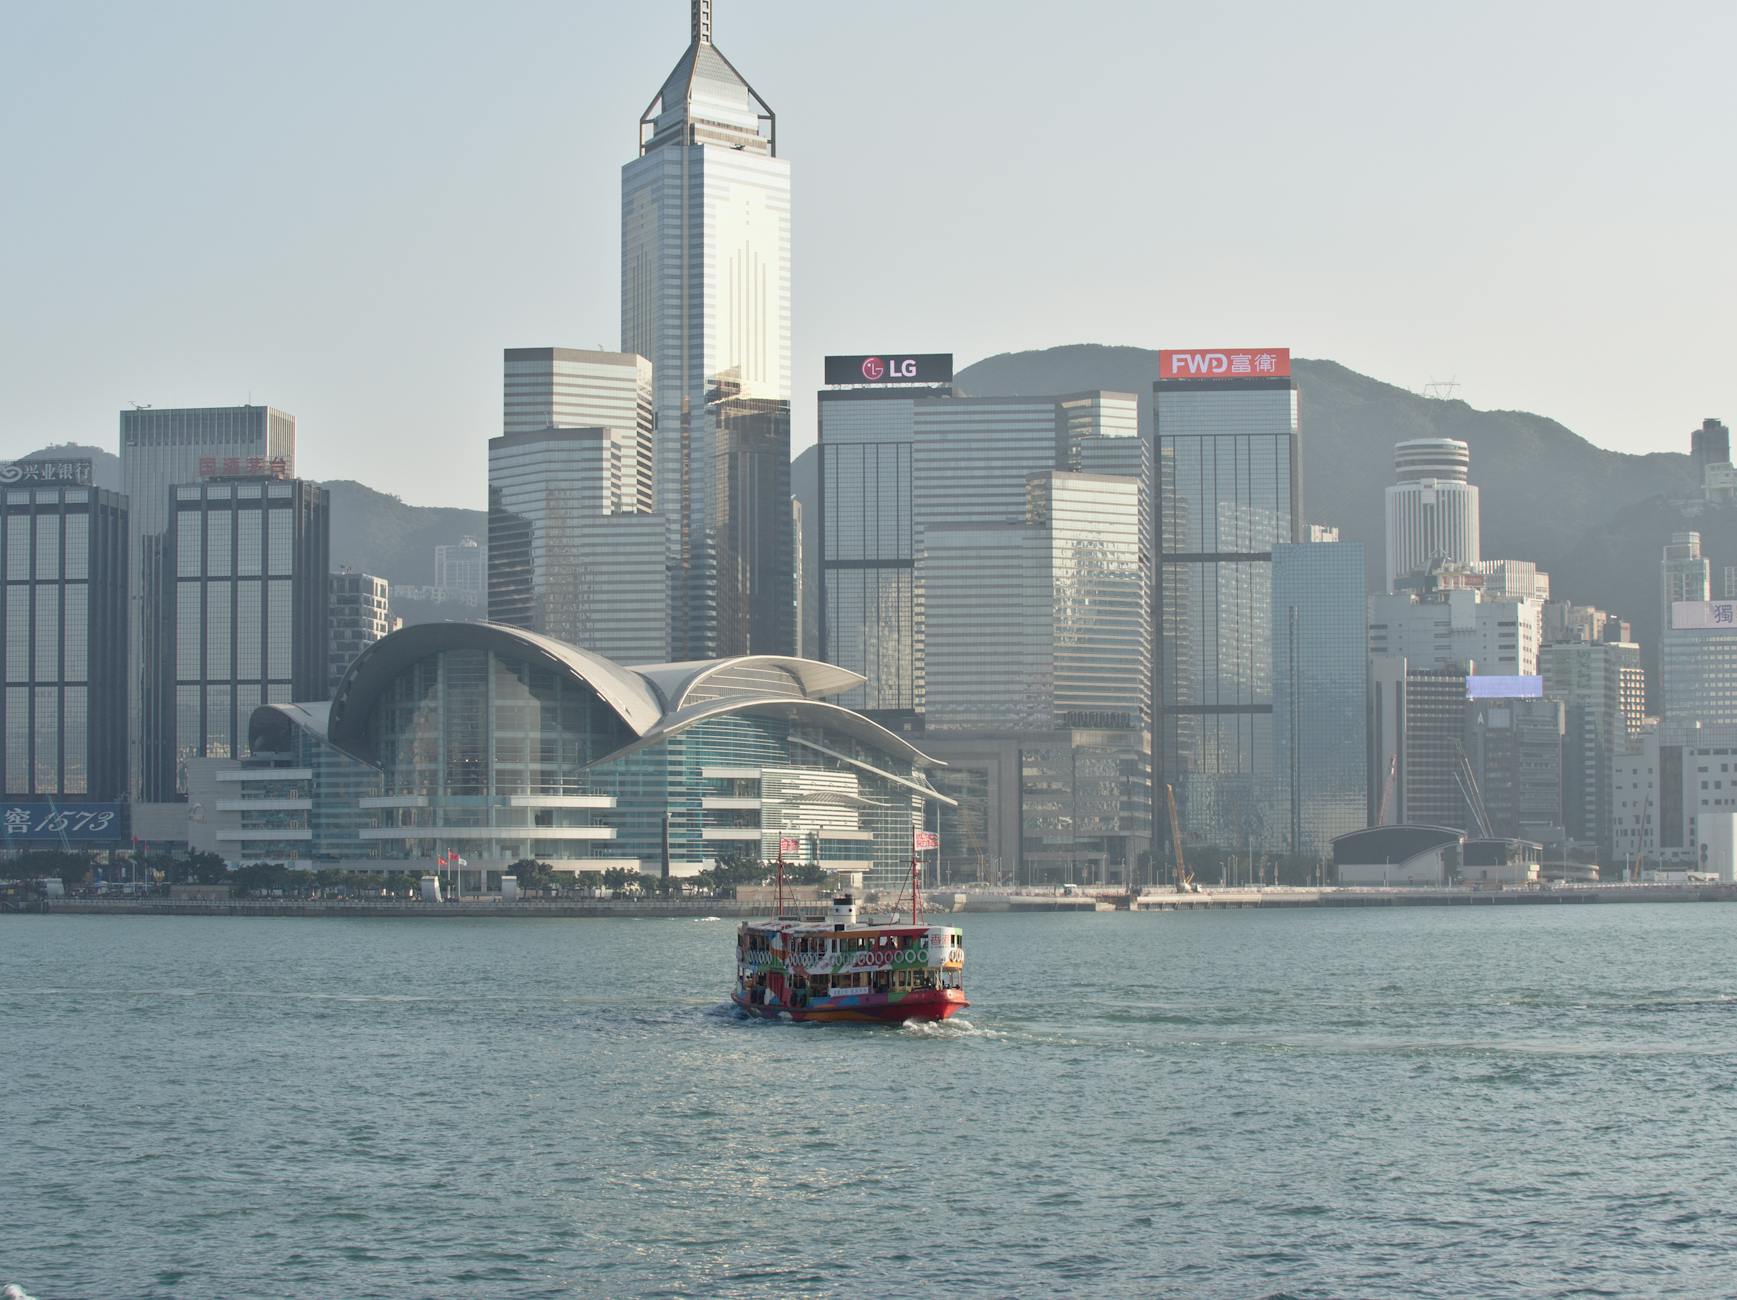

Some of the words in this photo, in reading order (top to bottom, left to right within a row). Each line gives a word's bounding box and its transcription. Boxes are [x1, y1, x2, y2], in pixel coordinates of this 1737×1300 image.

[889, 360, 917, 377] LG
[1172, 353, 1228, 374] FWD
[1231, 353, 1277, 373] 富衛
[23, 463, 90, 482] 兴业银行
